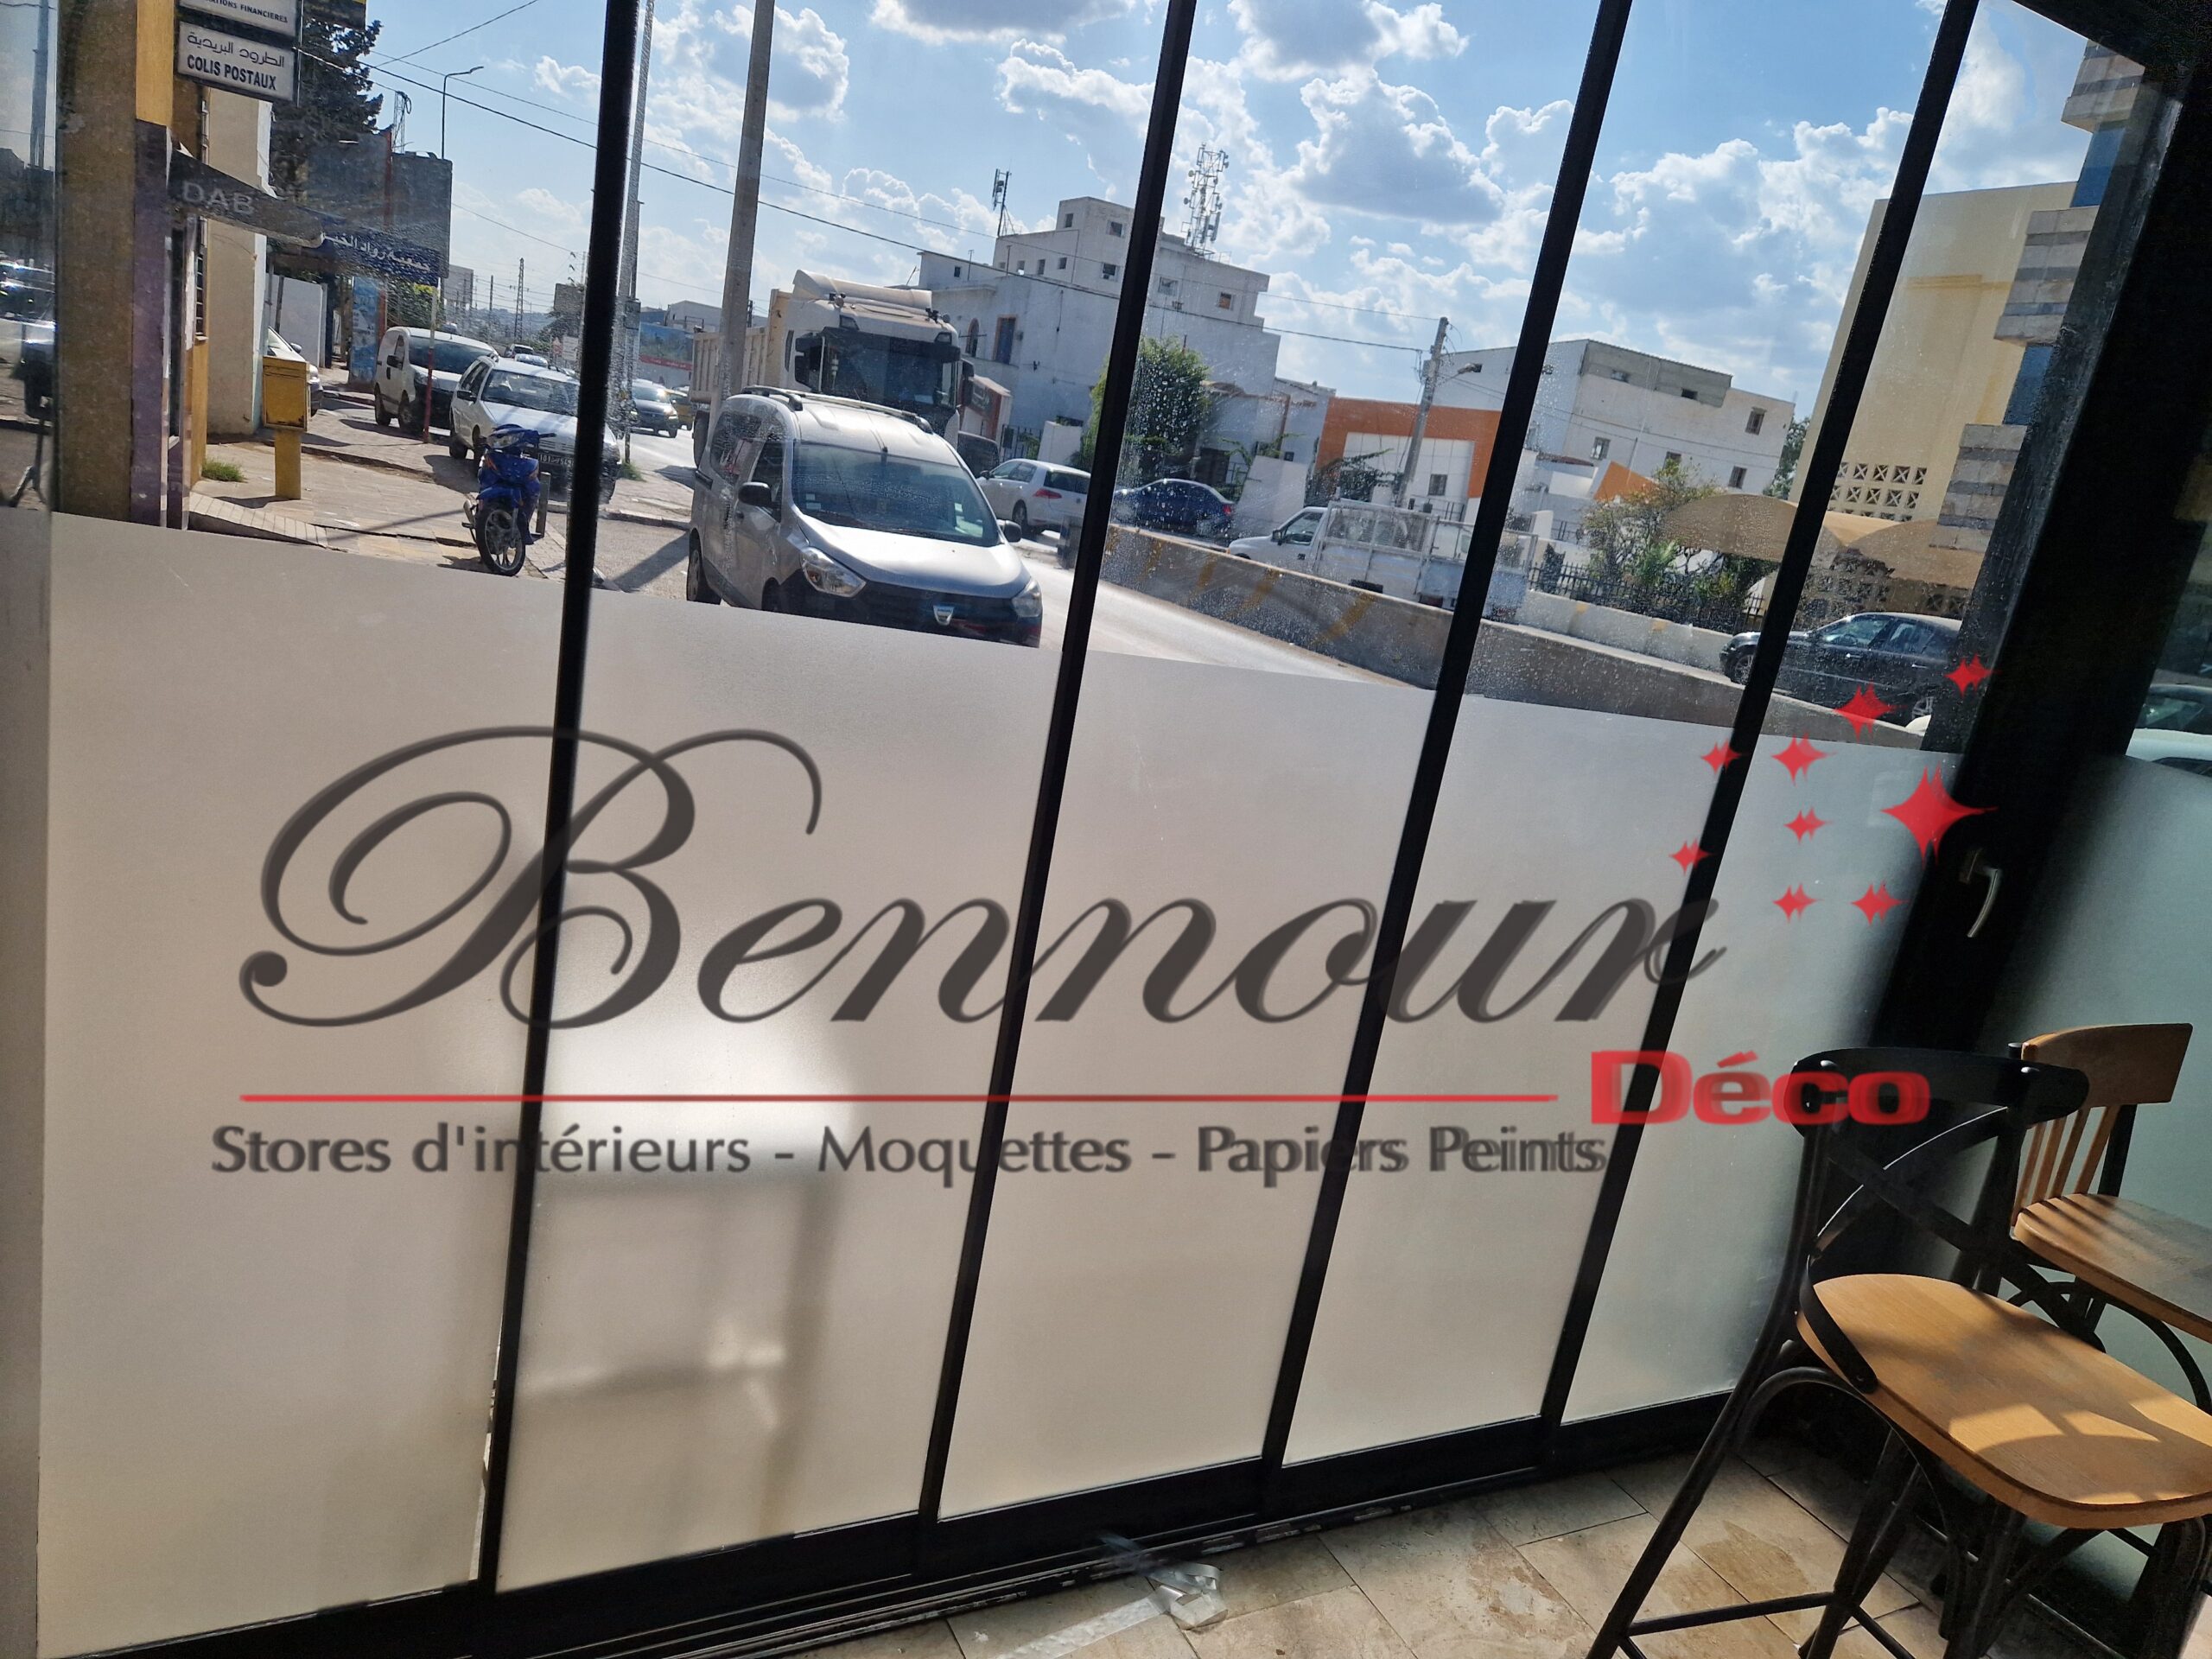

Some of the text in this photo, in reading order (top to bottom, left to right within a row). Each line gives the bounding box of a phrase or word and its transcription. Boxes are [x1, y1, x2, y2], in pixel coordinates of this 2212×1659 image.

[240, 5, 288, 22] FINANCIERES
[187, 31, 285, 67] الطرود البريدية
[187, 54, 276, 91] COLIS POSTAUX
[181, 181, 255, 215] DAB
